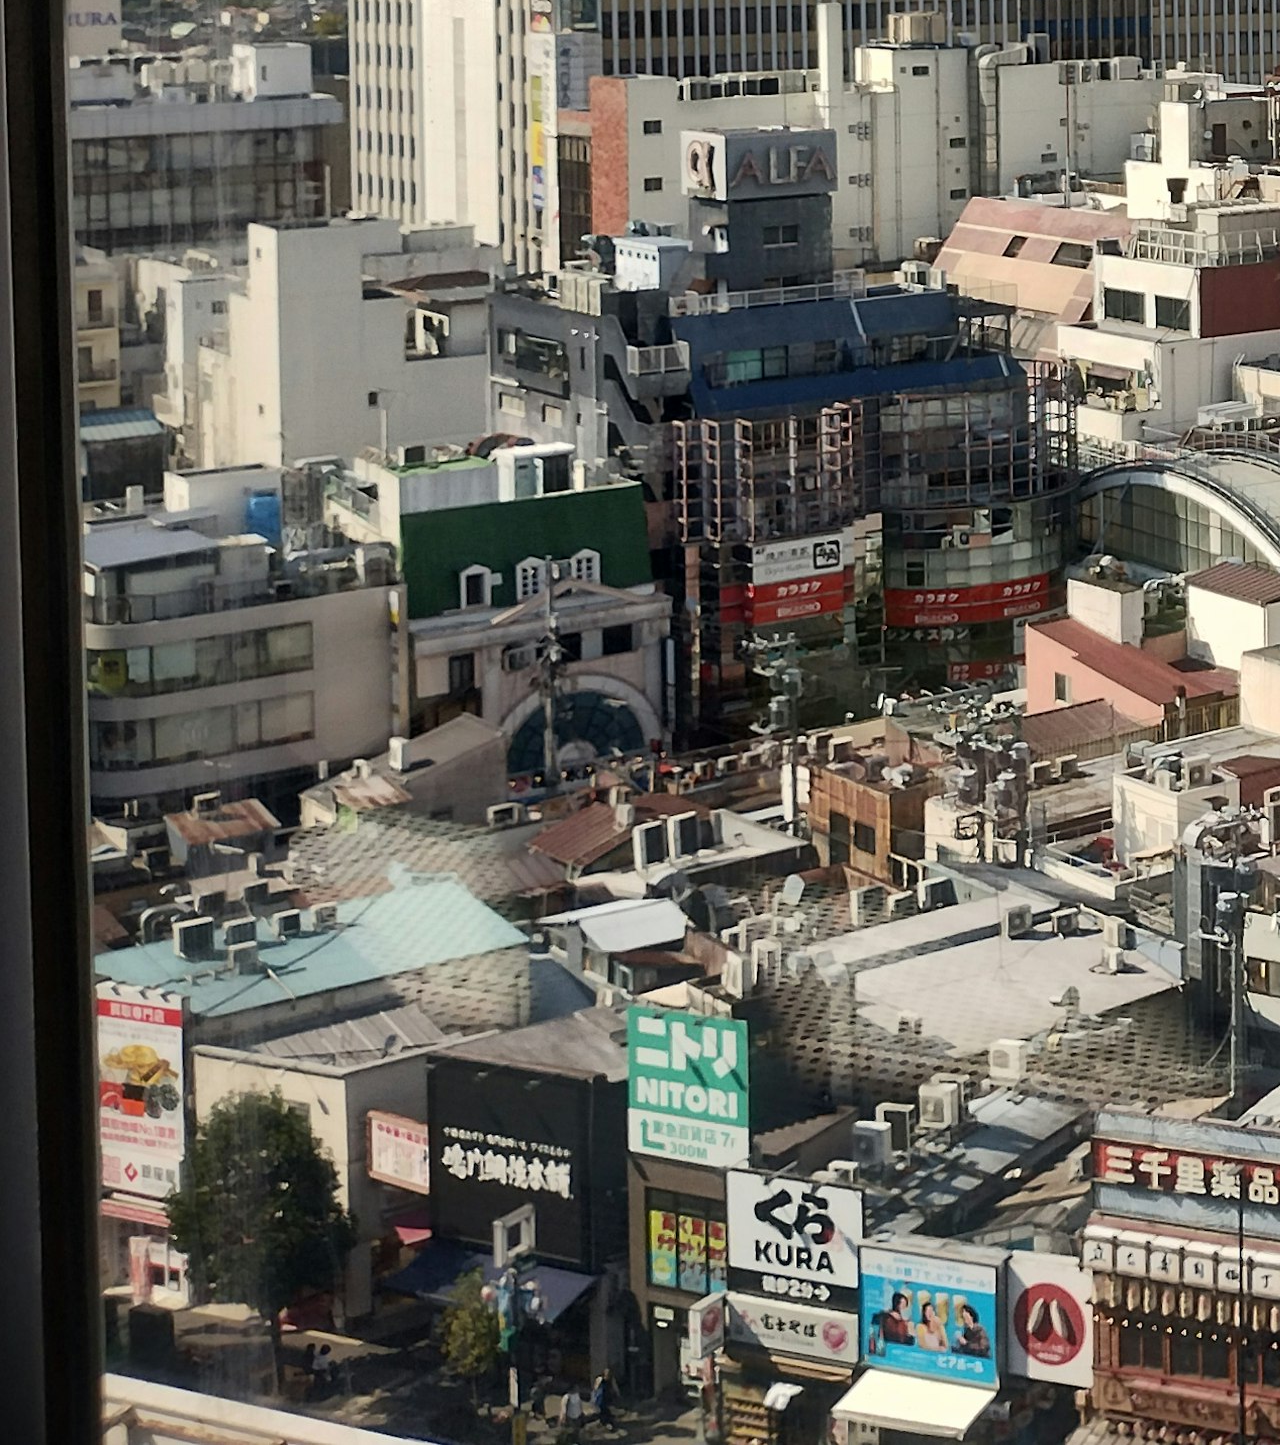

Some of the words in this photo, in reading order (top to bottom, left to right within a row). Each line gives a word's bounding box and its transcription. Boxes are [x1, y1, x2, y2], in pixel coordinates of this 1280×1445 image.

[730, 144, 837, 187] ALFA
[777, 581, 821, 597] カラオケ
[914, 592, 960, 604] カラオケ
[1003, 582, 1041, 597] カラオケ
[636, 1016, 738, 1079] ニトリ
[636, 1076, 739, 1119] NITORI
[652, 1117, 718, 1146] 東急百貨店
[1105, 1145, 1280, 1205] 三千里薬品
[754, 1188, 835, 1246] くら
[755, 1239, 835, 1275] KURA
[760, 1313, 818, 1338] 富士そば
